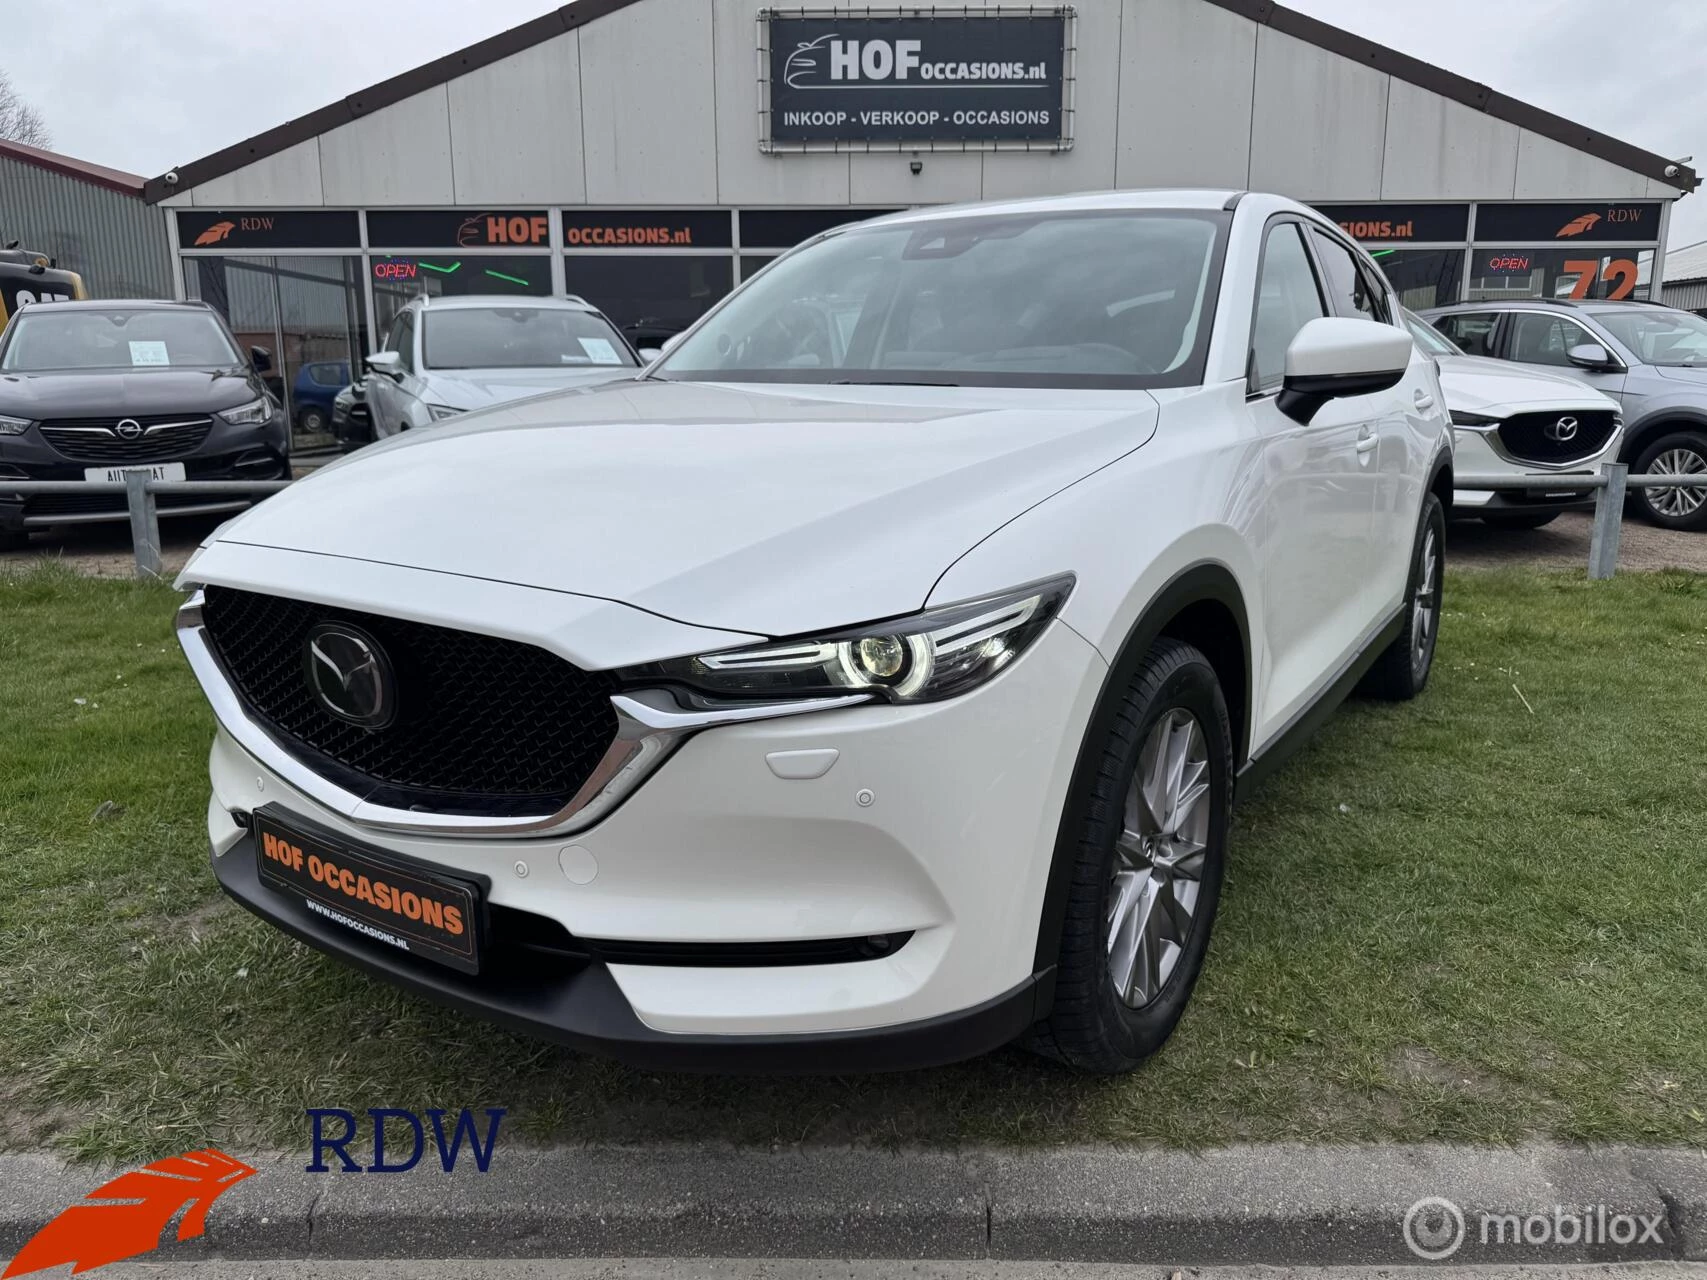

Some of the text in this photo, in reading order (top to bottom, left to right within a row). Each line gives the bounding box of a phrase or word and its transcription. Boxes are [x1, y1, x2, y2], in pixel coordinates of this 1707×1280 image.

[830, 39, 1047, 80] HOF OCCASIONS.nl
[784, 111, 847, 126] INKOOP
[859, 111, 940, 125] VERKOOP
[953, 110, 1050, 125] OCCASIONS
[241, 217, 274, 230] RDW
[1607, 209, 1642, 222] RDW
[487, 217, 692, 244] HOF OCCASIONS.nl
[375, 263, 417, 277] OPEN
[1489, 257, 1529, 269] OPEN
[1563, 259, 1639, 300] 72
[262, 831, 465, 936] HOF OCCASIONS
[306, 898, 410, 950] WWW.HOFOCCASIONS.NL
